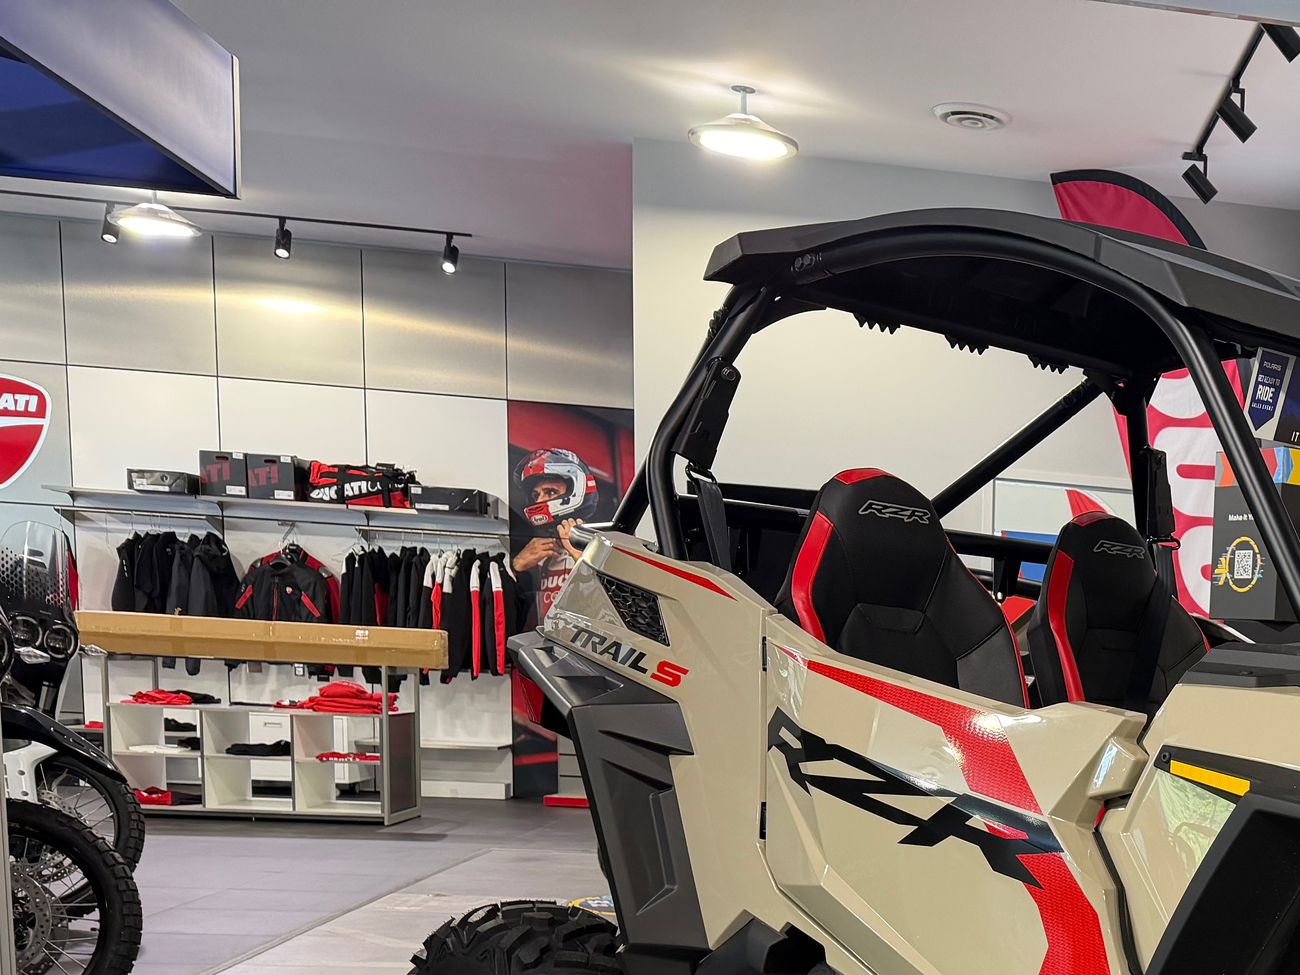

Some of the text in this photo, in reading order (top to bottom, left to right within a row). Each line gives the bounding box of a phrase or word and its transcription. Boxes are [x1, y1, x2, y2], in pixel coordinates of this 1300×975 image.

[1263, 361, 1282, 371] POLARIS
[1255, 384, 1275, 403] RIDE
[858, 500, 931, 524] RZR
[1093, 540, 1145, 559] RZR
[570, 625, 689, 688] TRAIL S
